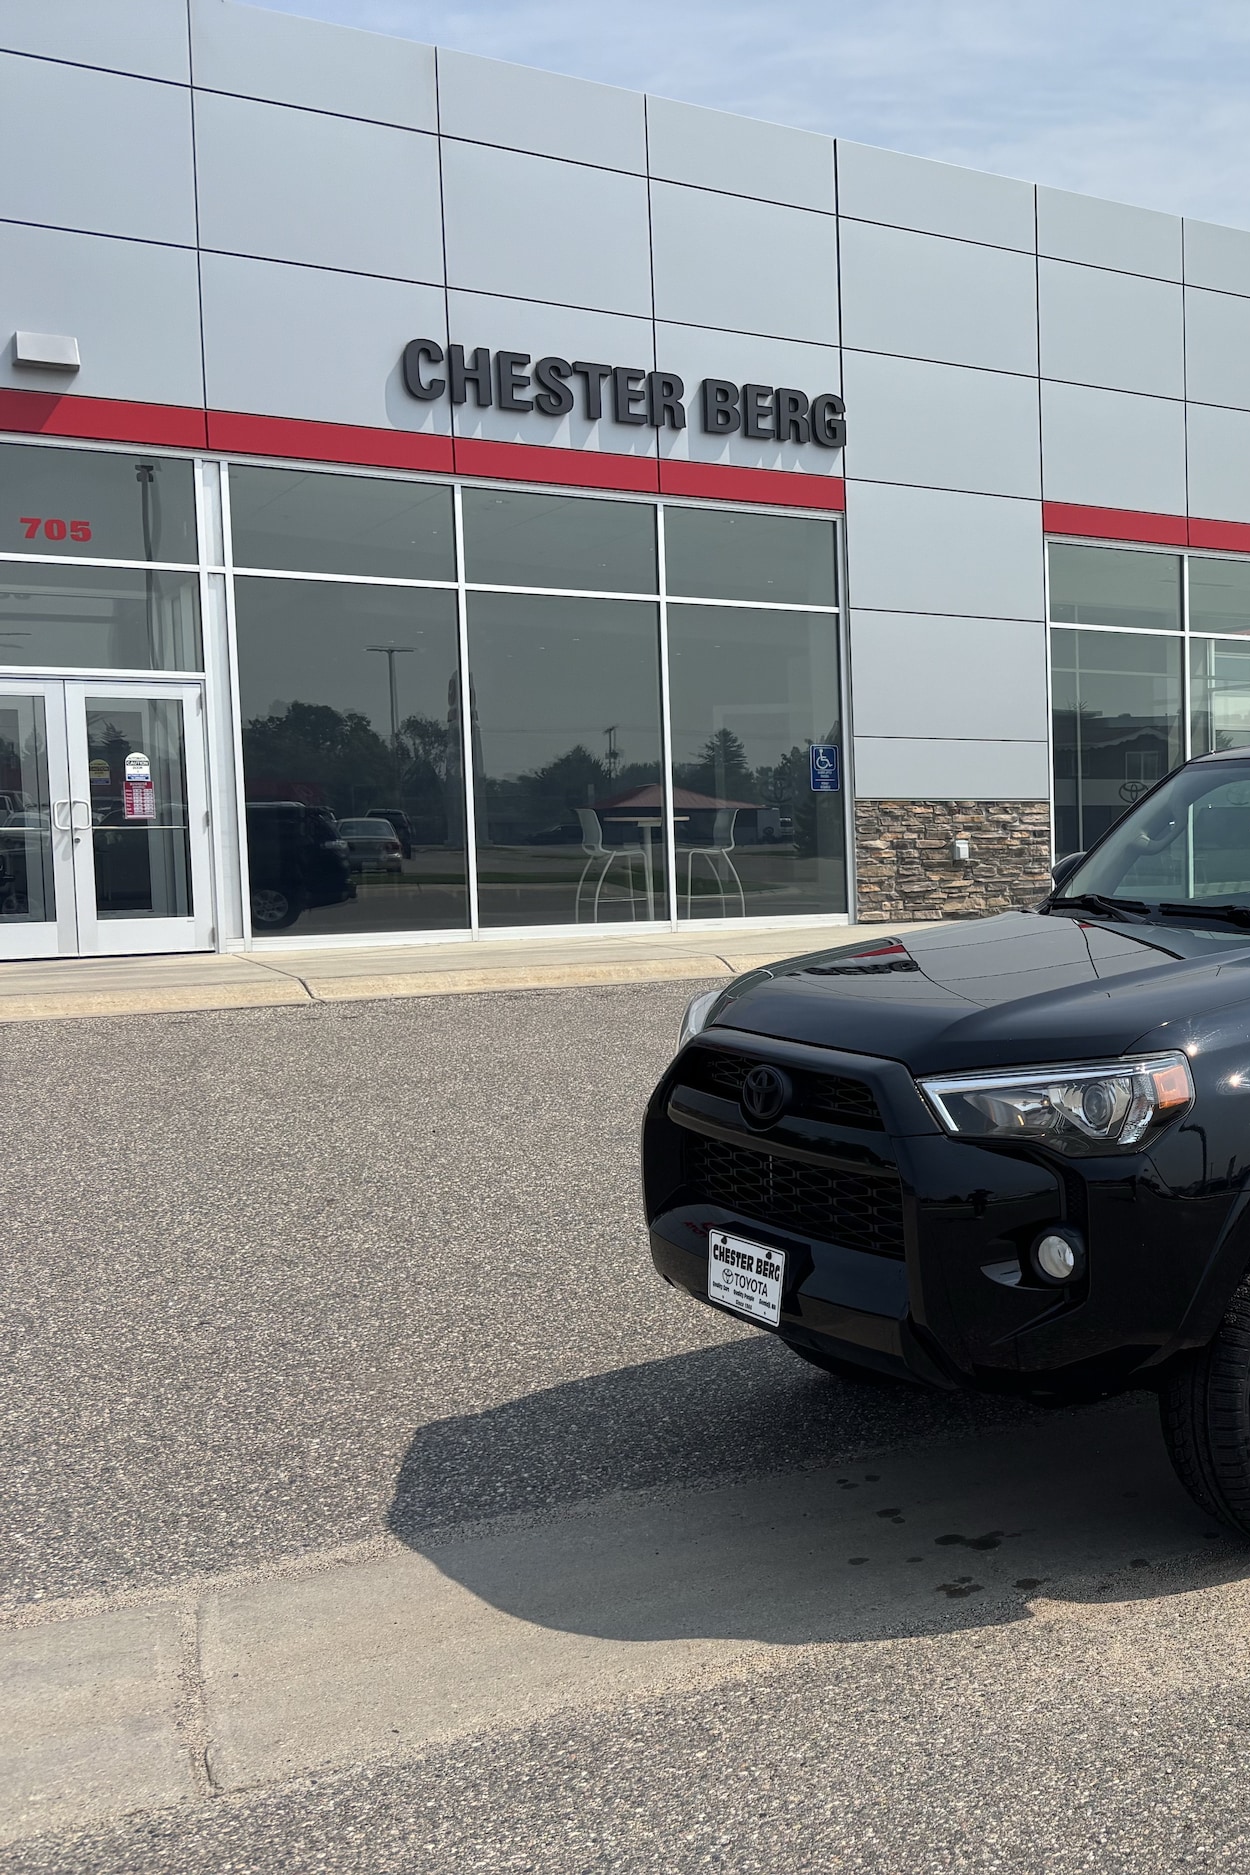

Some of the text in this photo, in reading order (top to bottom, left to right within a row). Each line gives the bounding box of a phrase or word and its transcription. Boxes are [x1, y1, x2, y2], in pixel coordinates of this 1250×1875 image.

[402, 338, 847, 448] CHESTER BERG
[19, 517, 92, 543] 705
[713, 1245, 780, 1282] CHESTER BERG
[734, 1272, 768, 1298] TOYOTA
